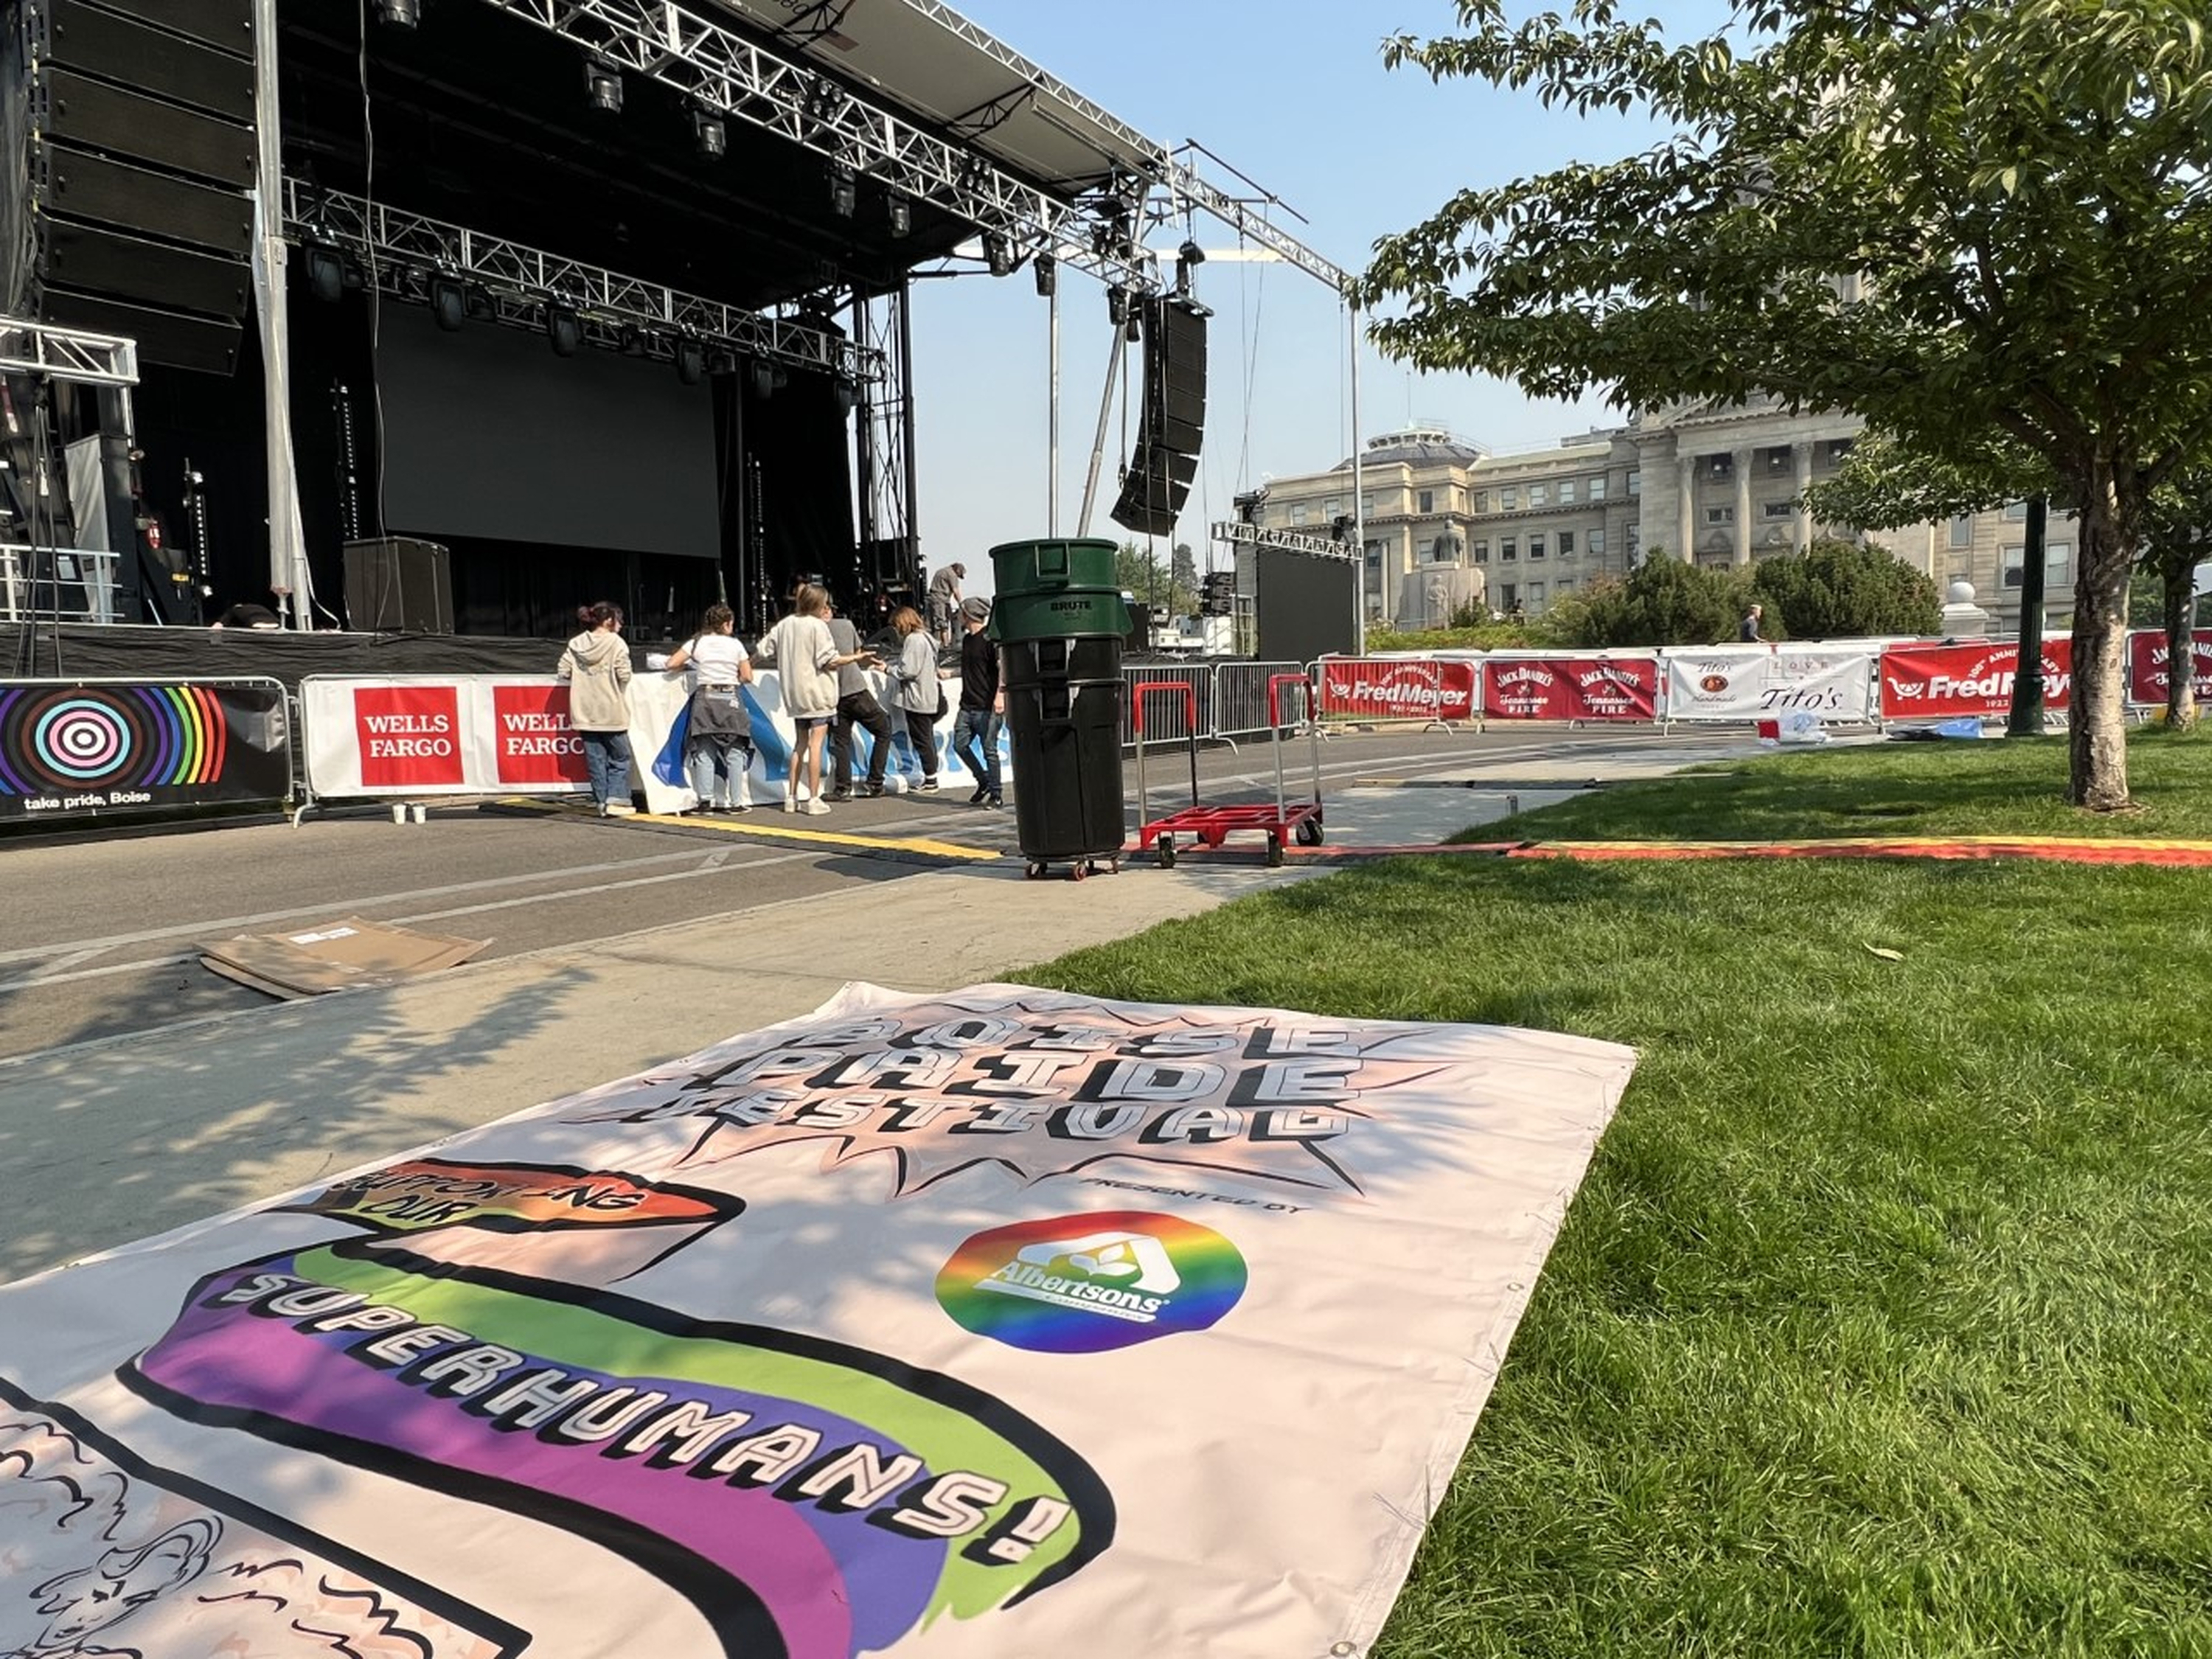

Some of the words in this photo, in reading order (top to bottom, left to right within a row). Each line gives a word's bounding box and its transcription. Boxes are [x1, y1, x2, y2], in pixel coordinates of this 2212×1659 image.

[1050, 600, 1092, 611] BRUTE
[1989, 648, 2061, 673] ANNIARY
[1498, 669, 1517, 687] JACK
[1519, 667, 1554, 687] DANIEL'S
[1580, 669, 1603, 687] JACK
[1759, 686, 1843, 710] Tito's
[1508, 705, 1540, 714] FIRE
[1593, 705, 1627, 714] FIRE
[364, 714, 449, 734] WELLS
[503, 713, 572, 732] WELL
[369, 737, 452, 758] FARGO
[24, 797, 60, 810] take
[63, 793, 107, 810] pride,
[110, 790, 151, 804] Boise
[681, 1045, 1364, 1107] PRIDE
[358, 1193, 479, 1224] OUR
[990, 1260, 1165, 1313] Albertsons
[202, 1273, 1073, 1565] SUPERHUMANS!
